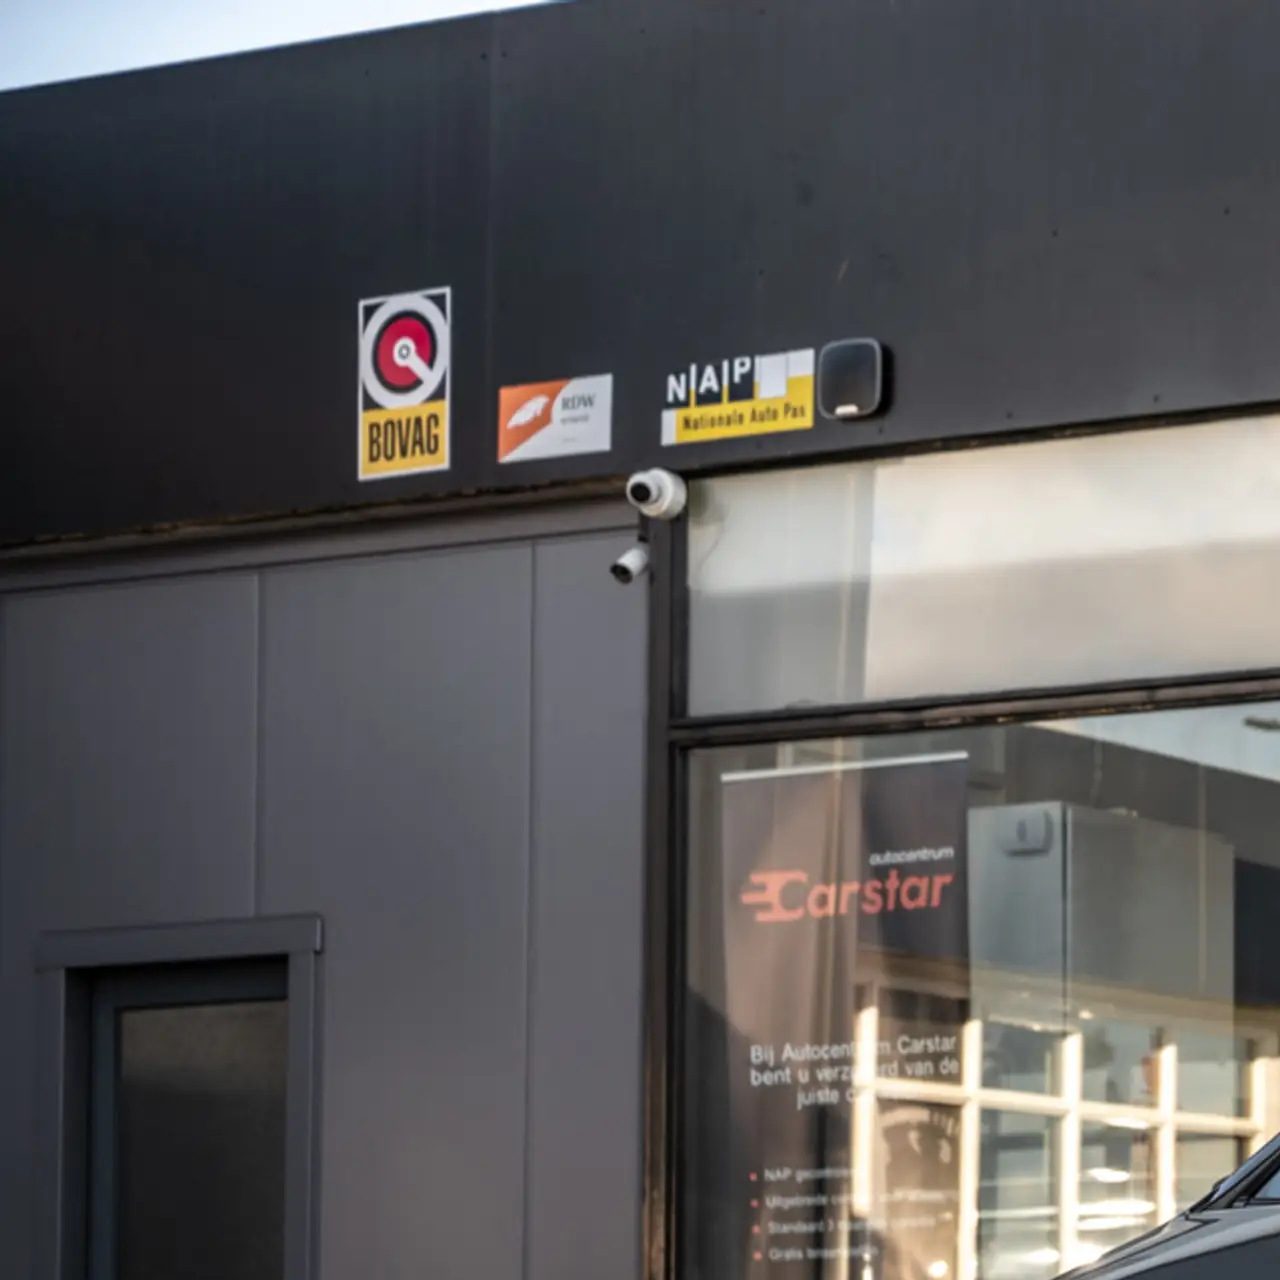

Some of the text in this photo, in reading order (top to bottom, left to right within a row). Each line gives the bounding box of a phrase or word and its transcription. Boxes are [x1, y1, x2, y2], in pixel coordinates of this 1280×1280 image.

[561, 393, 596, 411] RDW
[683, 402, 806, 431] Nationale Auto Pas
[368, 414, 439, 463] BOVAG
[869, 846, 955, 866] autocentrum
[741, 868, 956, 923] Carstar
[750, 1034, 957, 1068] Bij Autocenm Carstar
[750, 1056, 960, 1087] bent u verzrd van de
[796, 1087, 840, 1111] juiste
